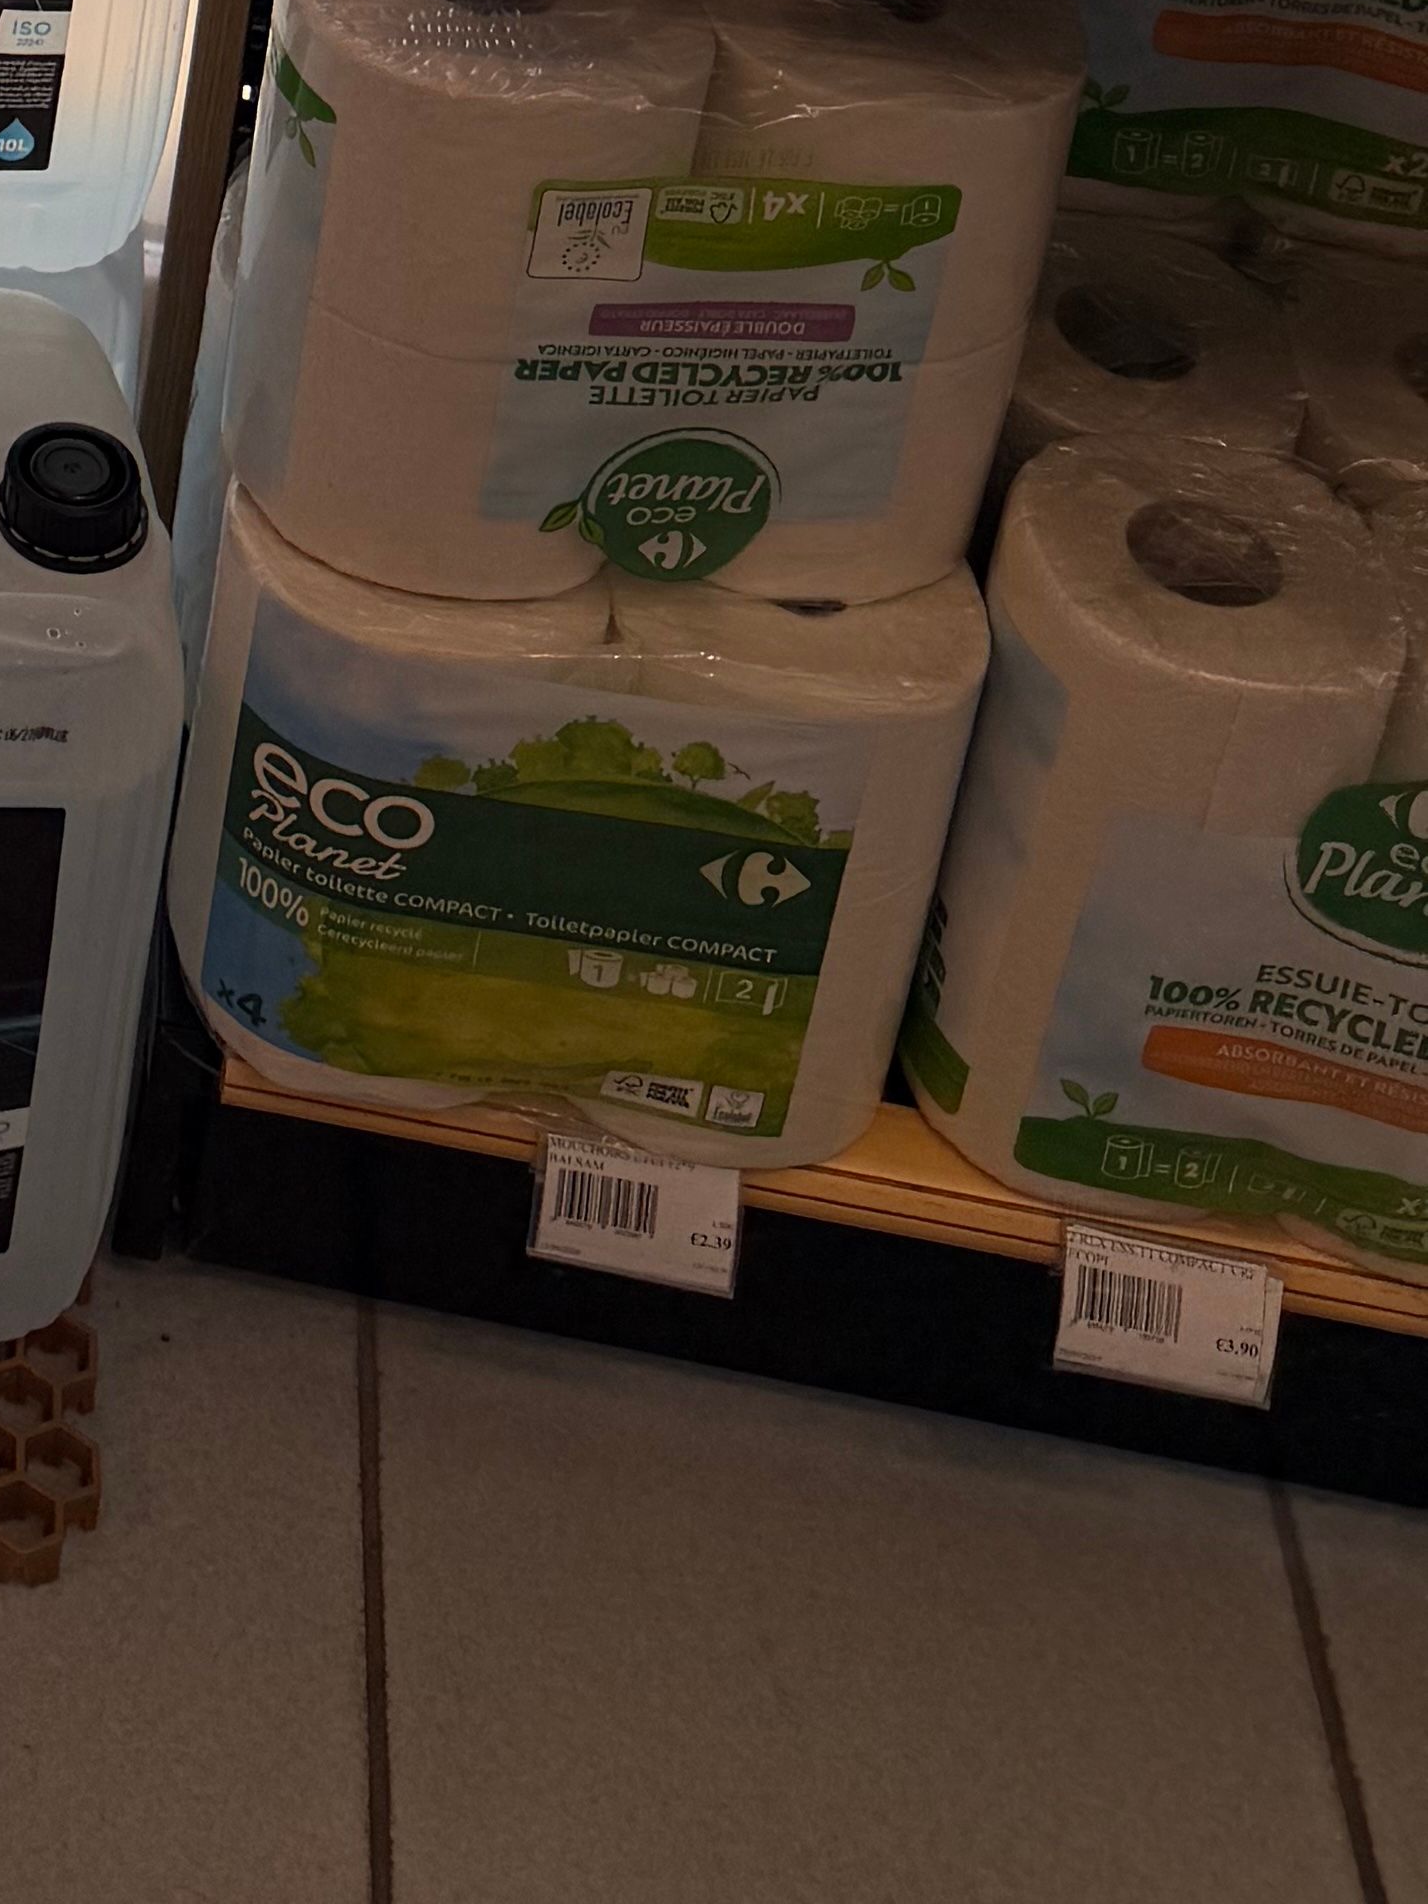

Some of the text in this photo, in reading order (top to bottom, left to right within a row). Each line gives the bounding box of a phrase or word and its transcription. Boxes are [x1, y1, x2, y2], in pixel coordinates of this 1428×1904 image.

[12, 20, 52, 37] ISO
[556, 198, 635, 228] Ecolabel
[762, 190, 809, 222] x4
[639, 319, 806, 338] DOUBLE ÉPAISSEUR
[537, 343, 602, 357] IGIENICA
[604, 345, 651, 359] CARTA
[740, 346, 786, 360] PAPEL
[795, 346, 893, 361] TOILETPAPIER
[513, 358, 904, 389] 100% RECYCLED PAPER
[587, 384, 820, 407] PAPIER TOILETTE
[604, 471, 768, 514] Planet
[626, 505, 697, 526] eco
[251, 741, 437, 850] eco
[247, 789, 408, 881] Planet
[237, 855, 310, 930] 100%
[305, 866, 778, 965] toilette COMPACT Toiletpapier COMPACT
[319, 905, 424, 942] Papier recyclé
[216, 976, 267, 1027] x4
[1148, 973, 1243, 1013] 100%
[1144, 1003, 1420, 1077] PAPIERTOREN TORRES PAPEL
[548, 1153, 607, 1172] BALSAM
[690, 1232, 733, 1251] €2.39
[1215, 1337, 1260, 1360] €3.90
